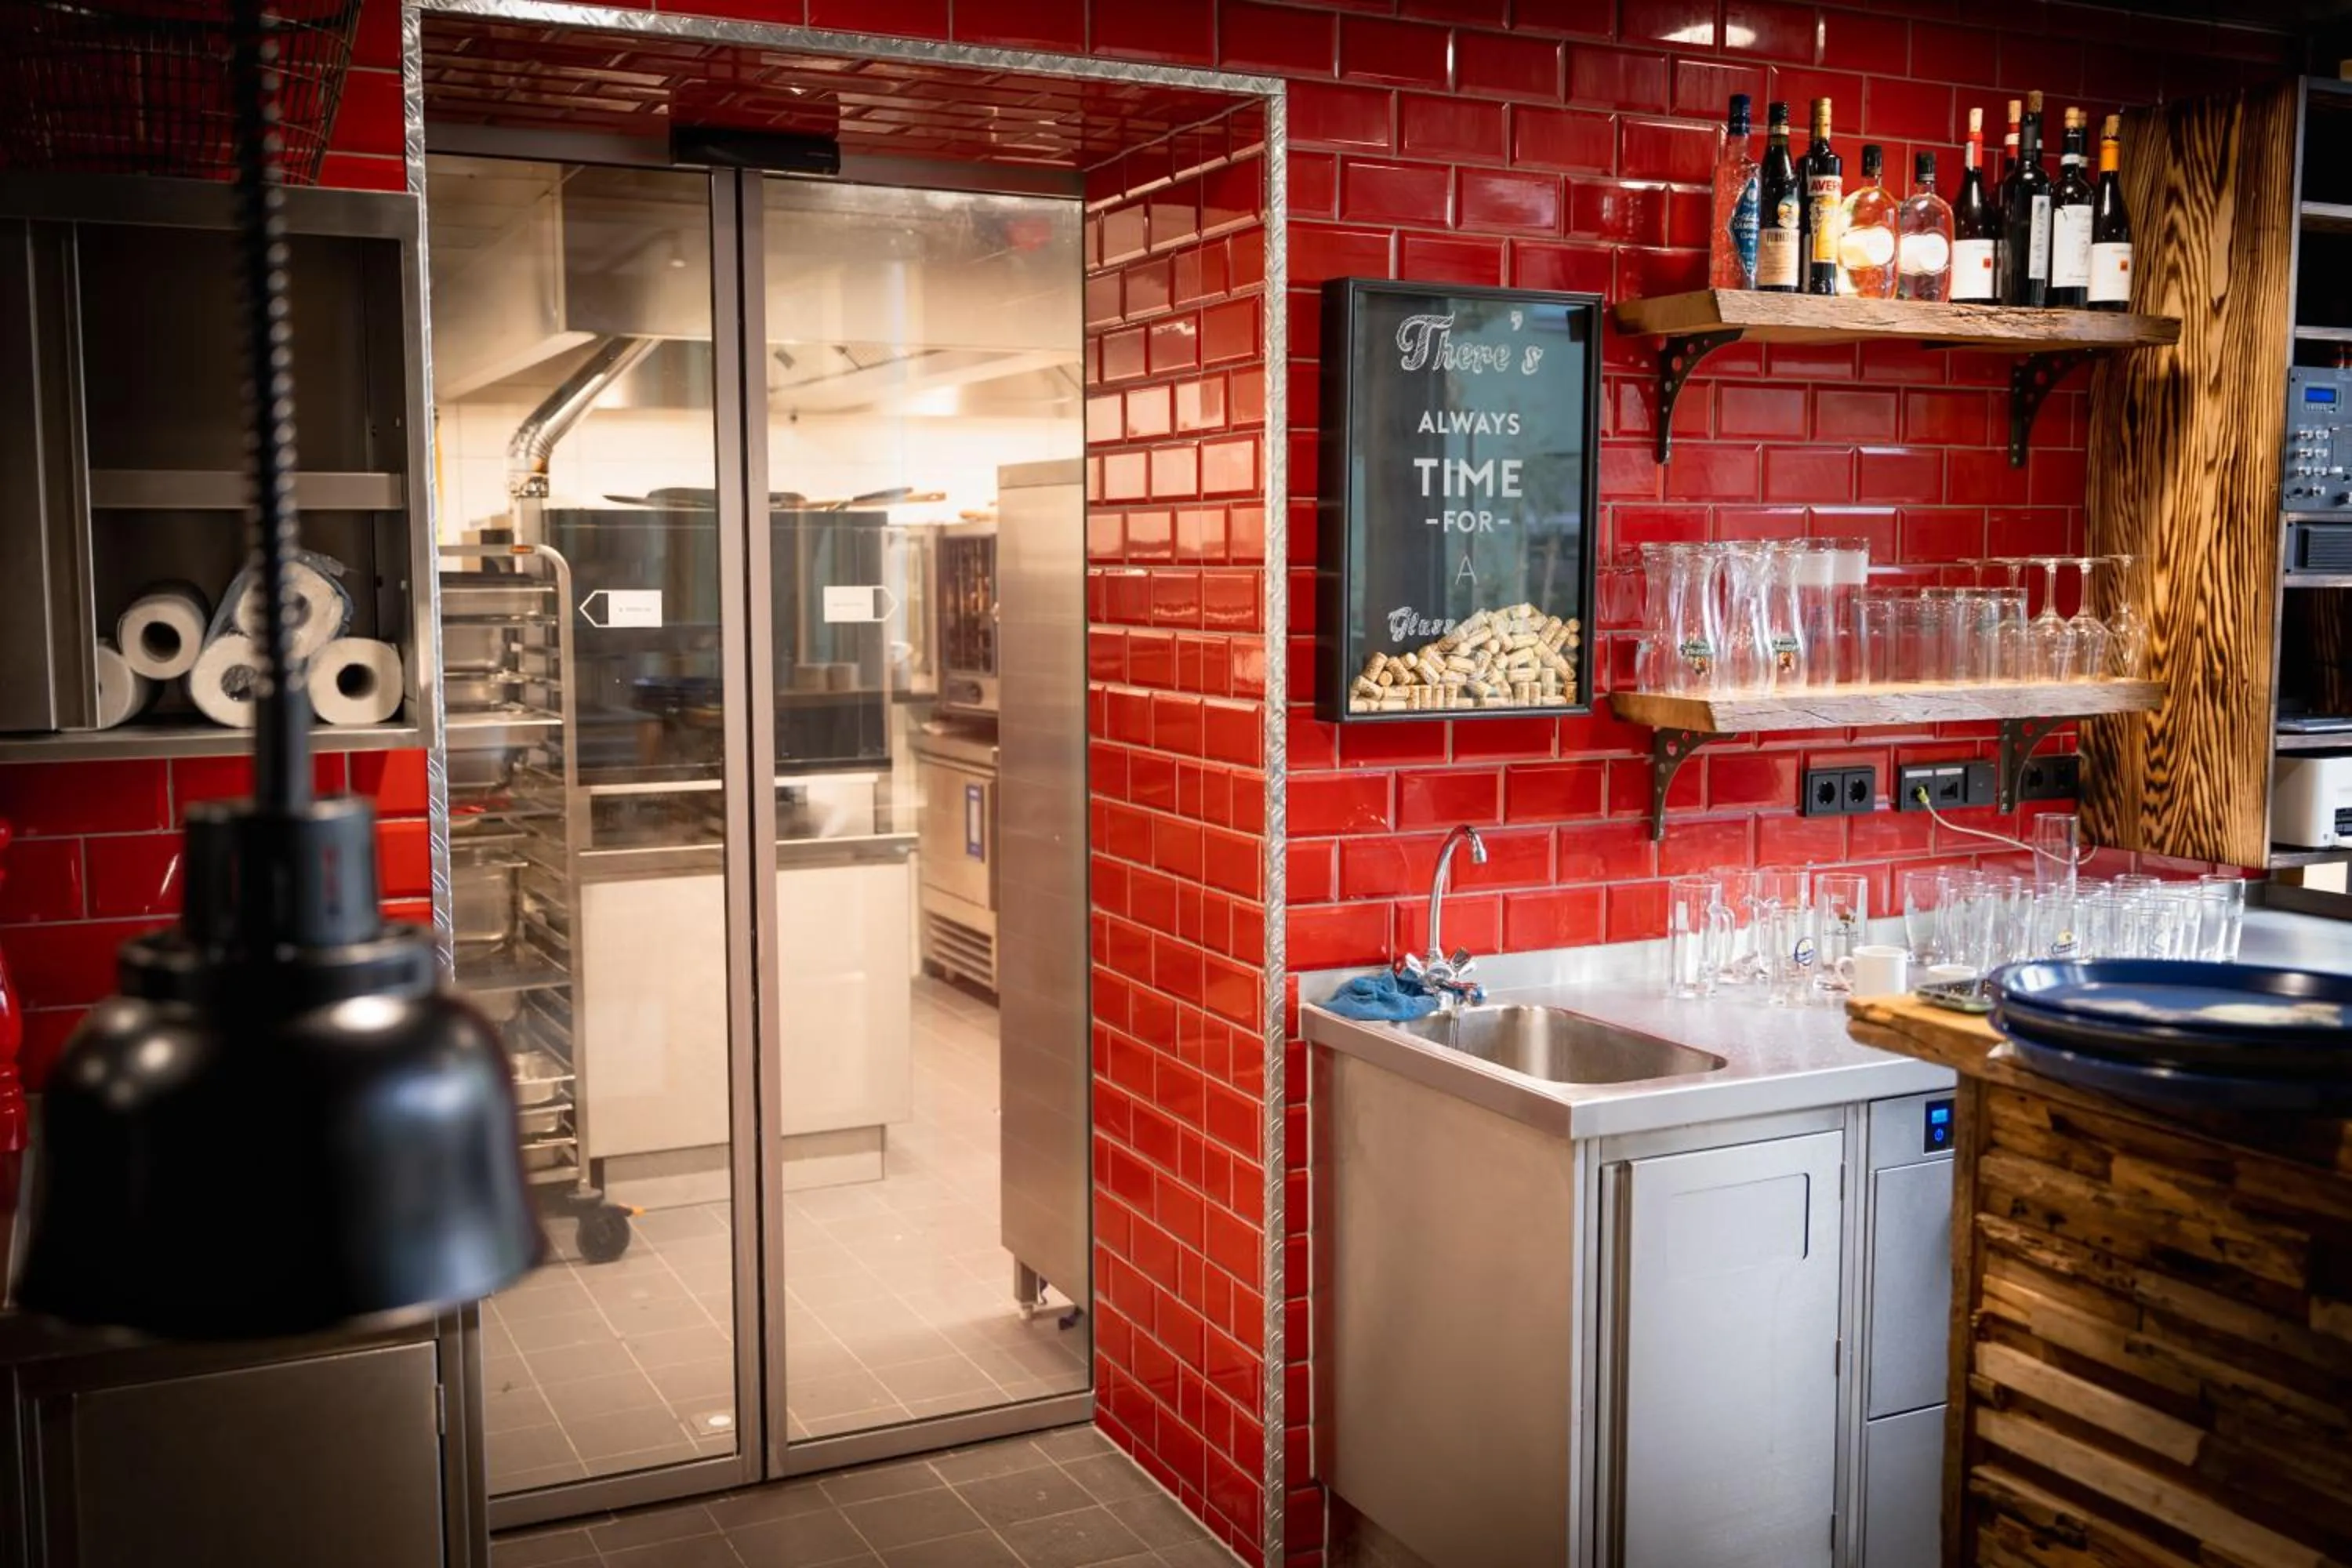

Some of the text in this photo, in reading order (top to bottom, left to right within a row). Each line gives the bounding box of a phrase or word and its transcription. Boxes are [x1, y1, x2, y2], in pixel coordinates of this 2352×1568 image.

[1396, 310, 1544, 375] There's
[1417, 410, 1520, 434] ALWAYS
[1414, 458, 1523, 498] TIME
[1455, 554, 1478, 585] A
[1387, 606, 1456, 642] Glass
